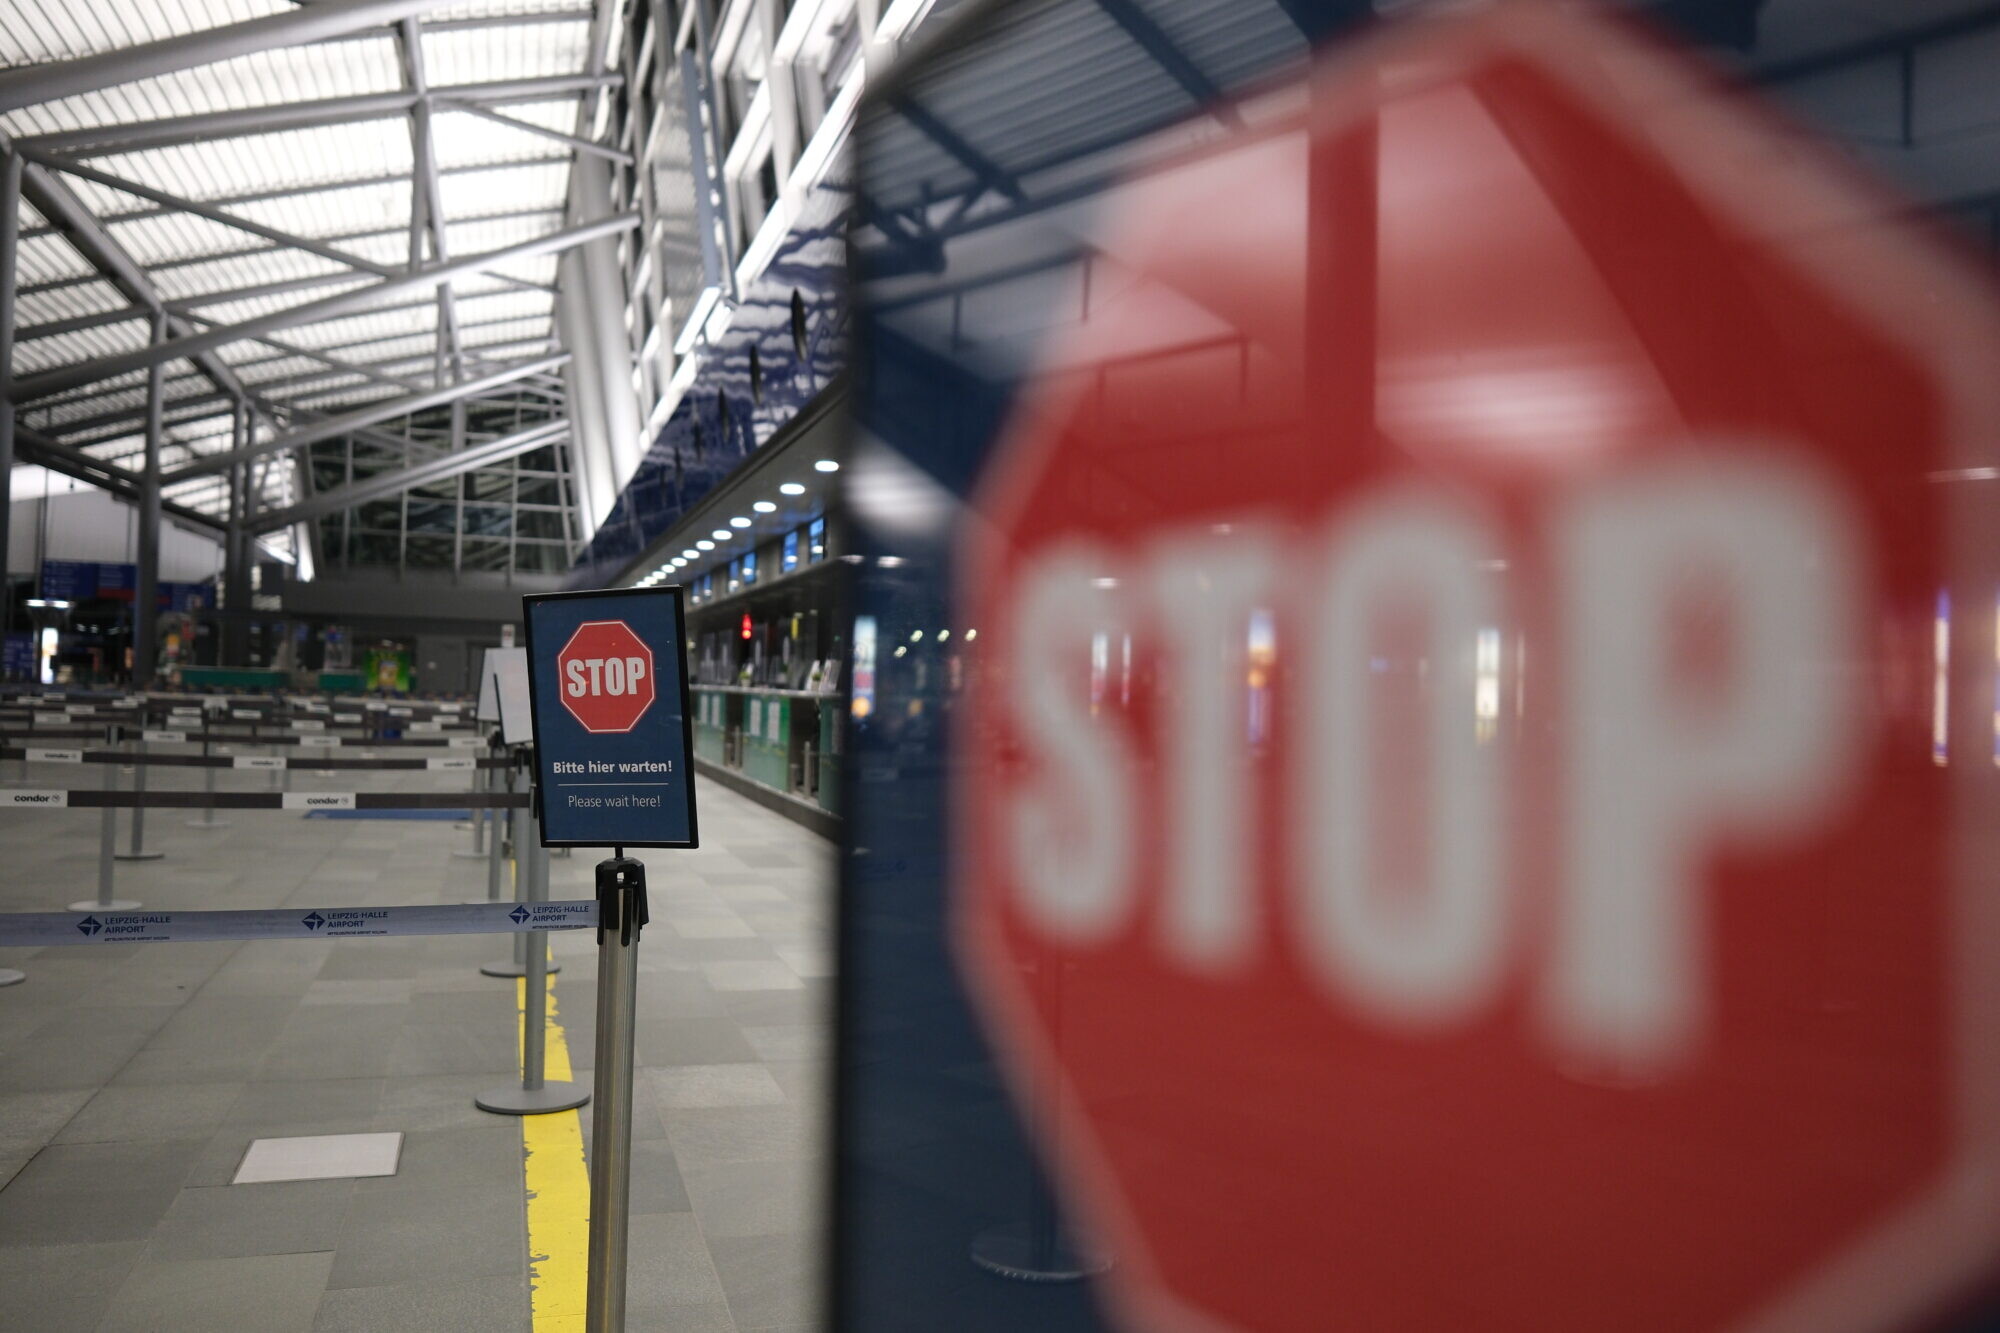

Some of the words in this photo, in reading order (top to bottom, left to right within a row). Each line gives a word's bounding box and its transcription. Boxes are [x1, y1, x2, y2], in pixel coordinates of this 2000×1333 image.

[566, 657, 645, 698] STOP
[1008, 448, 1868, 1068] STOP
[553, 761, 585, 774] Bitte
[588, 760, 615, 773] hier
[618, 760, 673, 773] warten!
[14, 794, 50, 803] condor
[307, 797, 340, 805] condor
[568, 795, 602, 808] Please
[605, 795, 629, 807] wait
[632, 795, 661, 807] here!
[532, 914, 567, 922] AIRPORT
[327, 920, 365, 928] AIRPORT
